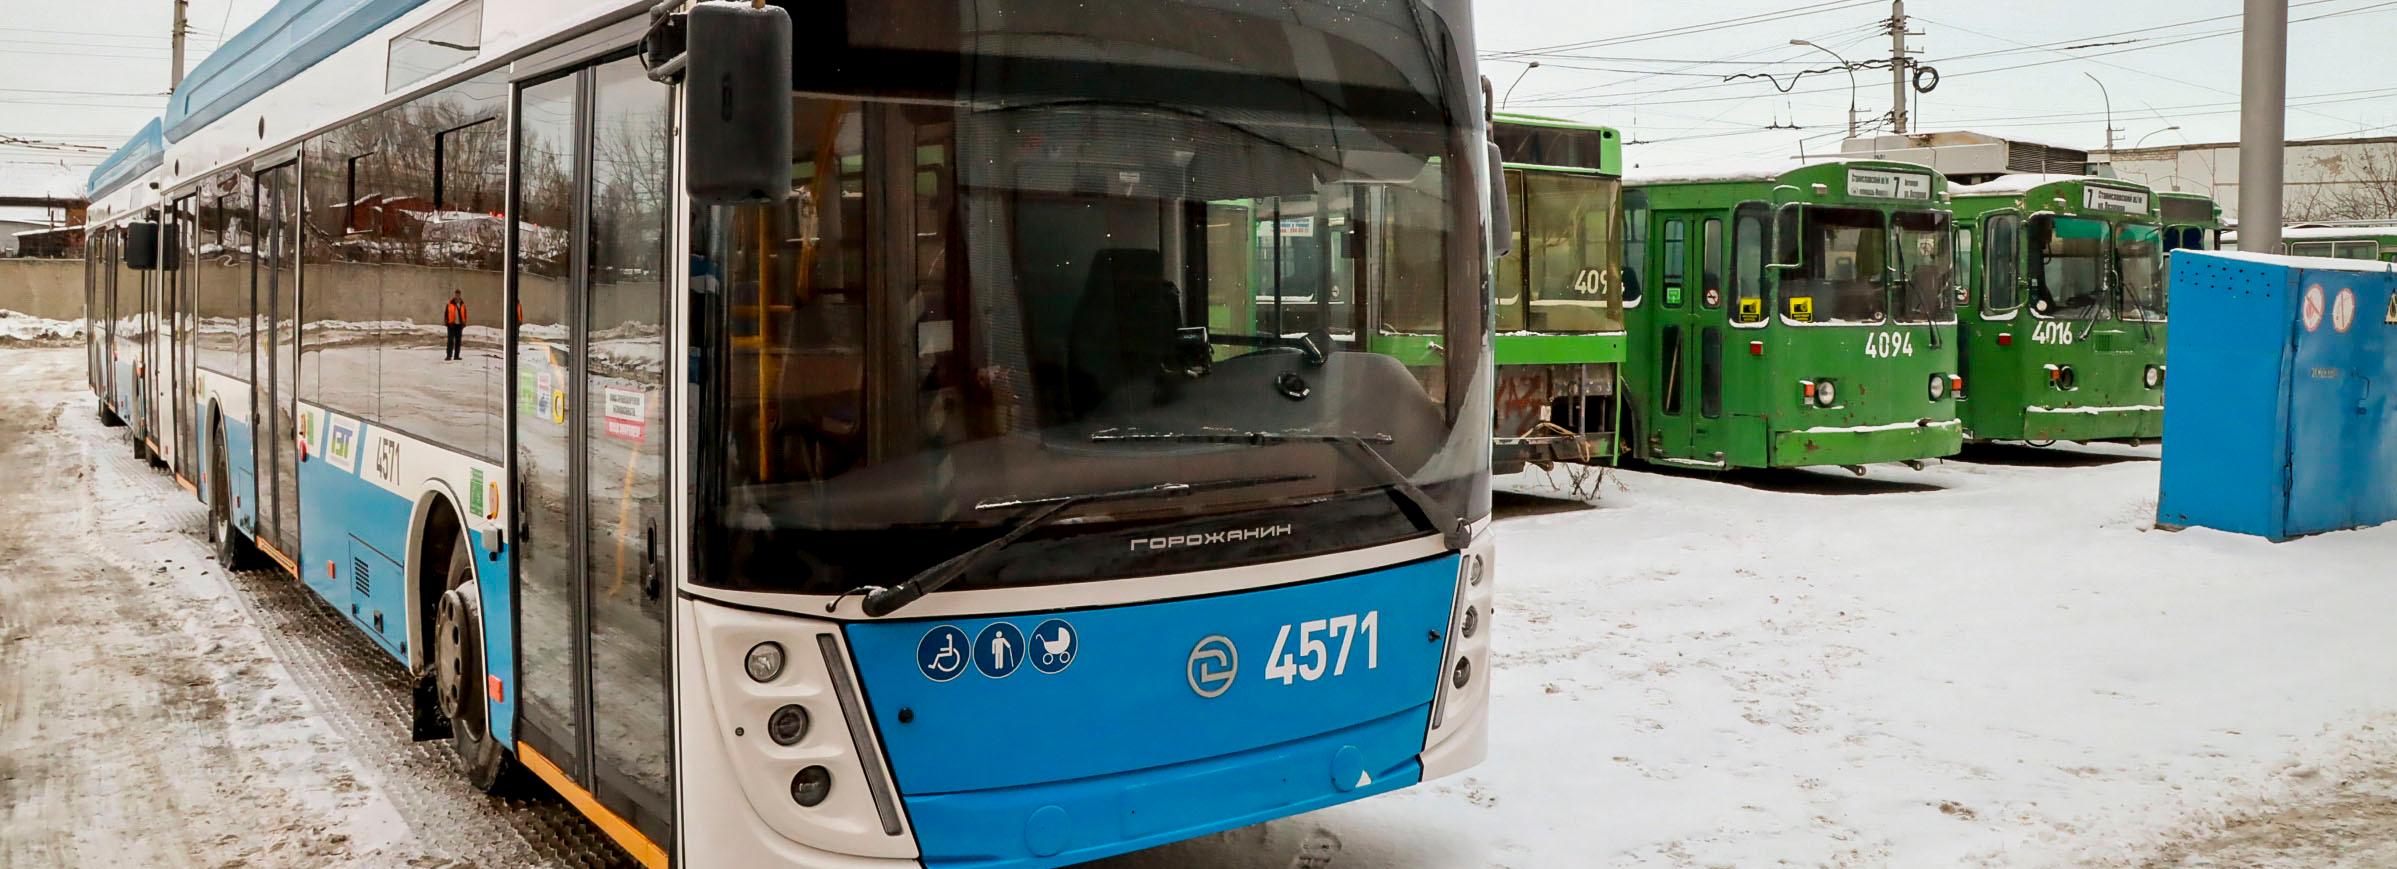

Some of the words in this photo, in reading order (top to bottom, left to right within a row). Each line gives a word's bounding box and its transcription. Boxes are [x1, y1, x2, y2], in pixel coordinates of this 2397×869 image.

[1894, 176, 1900, 198] 7
[2088, 189, 2093, 208] 7
[1575, 270, 1625, 294] 409
[1865, 332, 1913, 358] 4094
[2032, 321, 2073, 344] 4016
[376, 436, 400, 486] 4571
[1130, 523, 1291, 551] ГОРОЖАНИН
[1265, 610, 1379, 685] 4571
